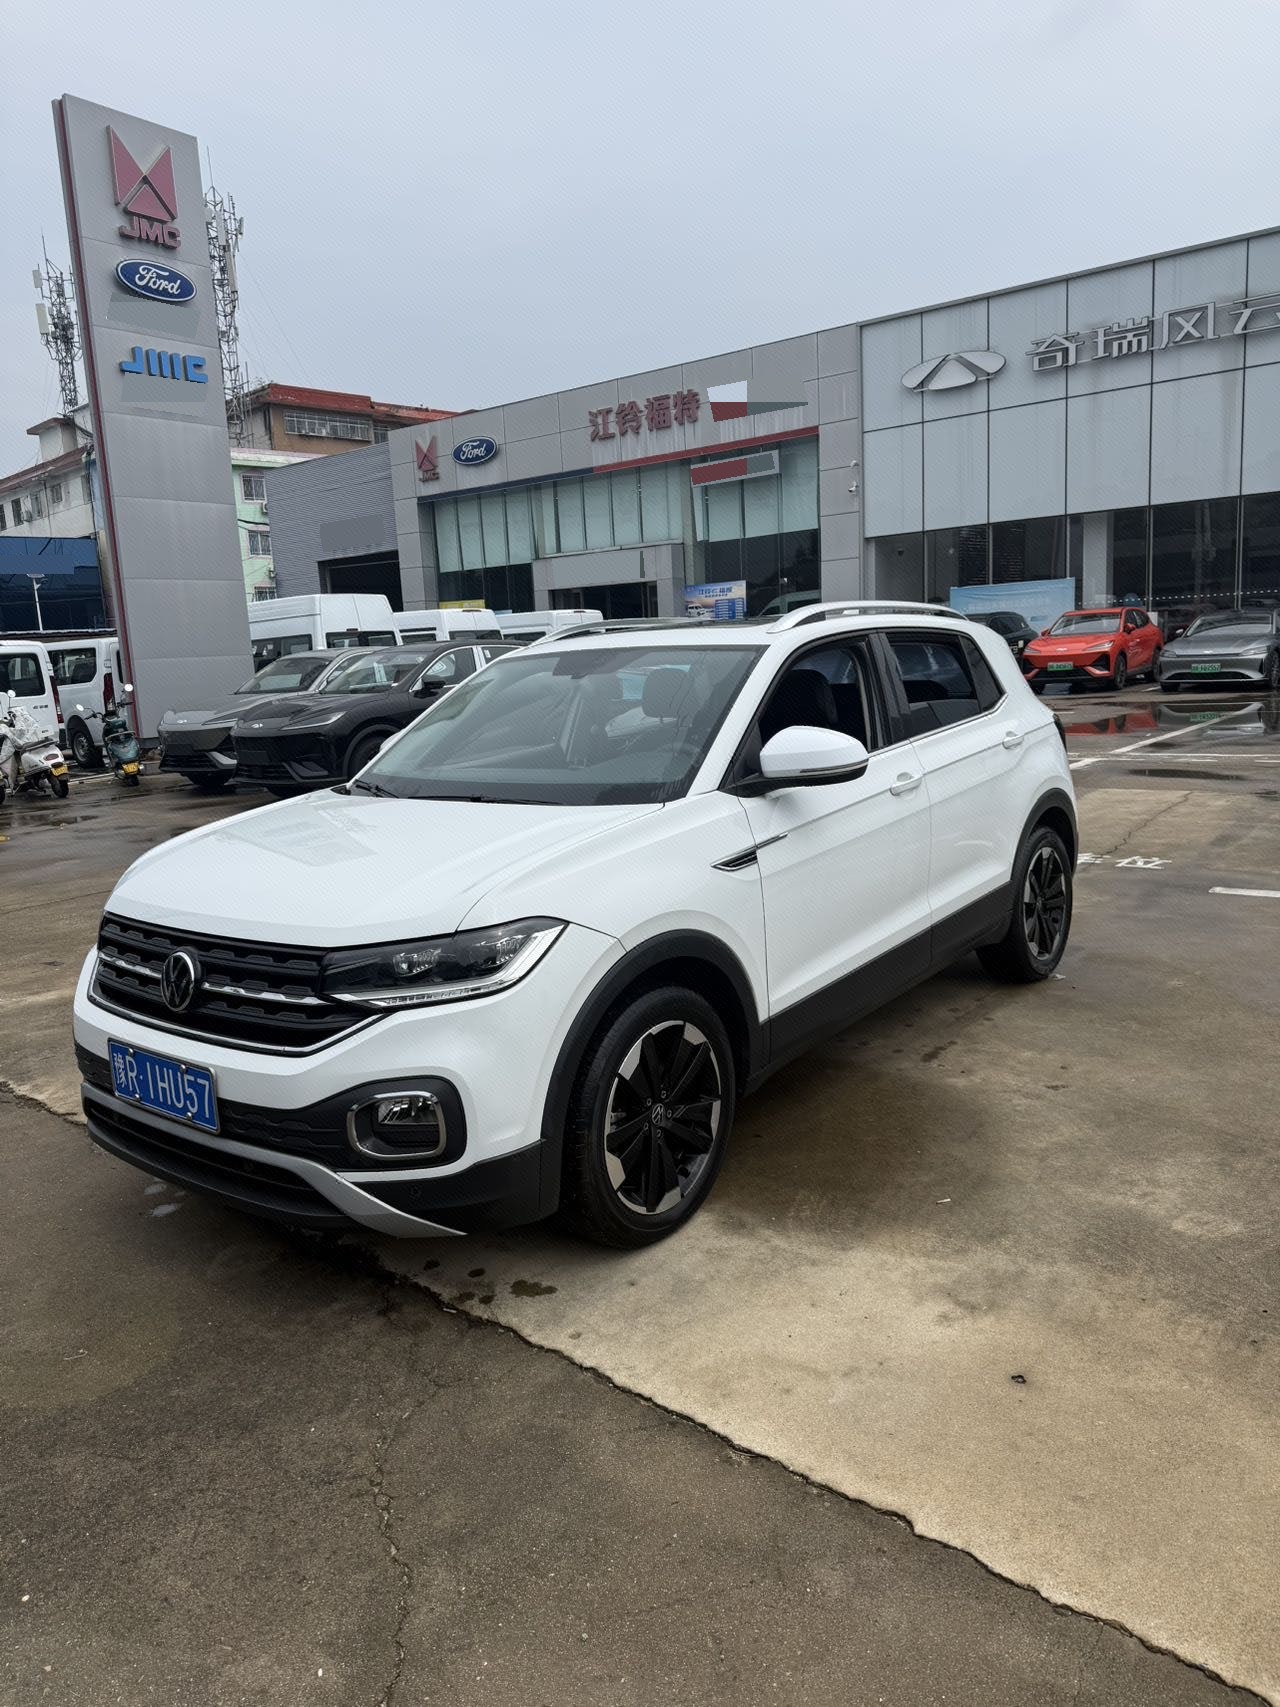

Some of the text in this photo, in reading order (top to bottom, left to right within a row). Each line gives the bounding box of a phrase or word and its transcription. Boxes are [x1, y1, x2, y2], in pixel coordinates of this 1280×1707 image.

[119, 215, 182, 250] JMC
[134, 265, 181, 295] Ford
[588, 388, 701, 442] 江铃福特
[460, 440, 487, 460] Ford
[419, 471, 440, 483] JMC
[113, 1052, 210, 1119] 豫R·1HU57
